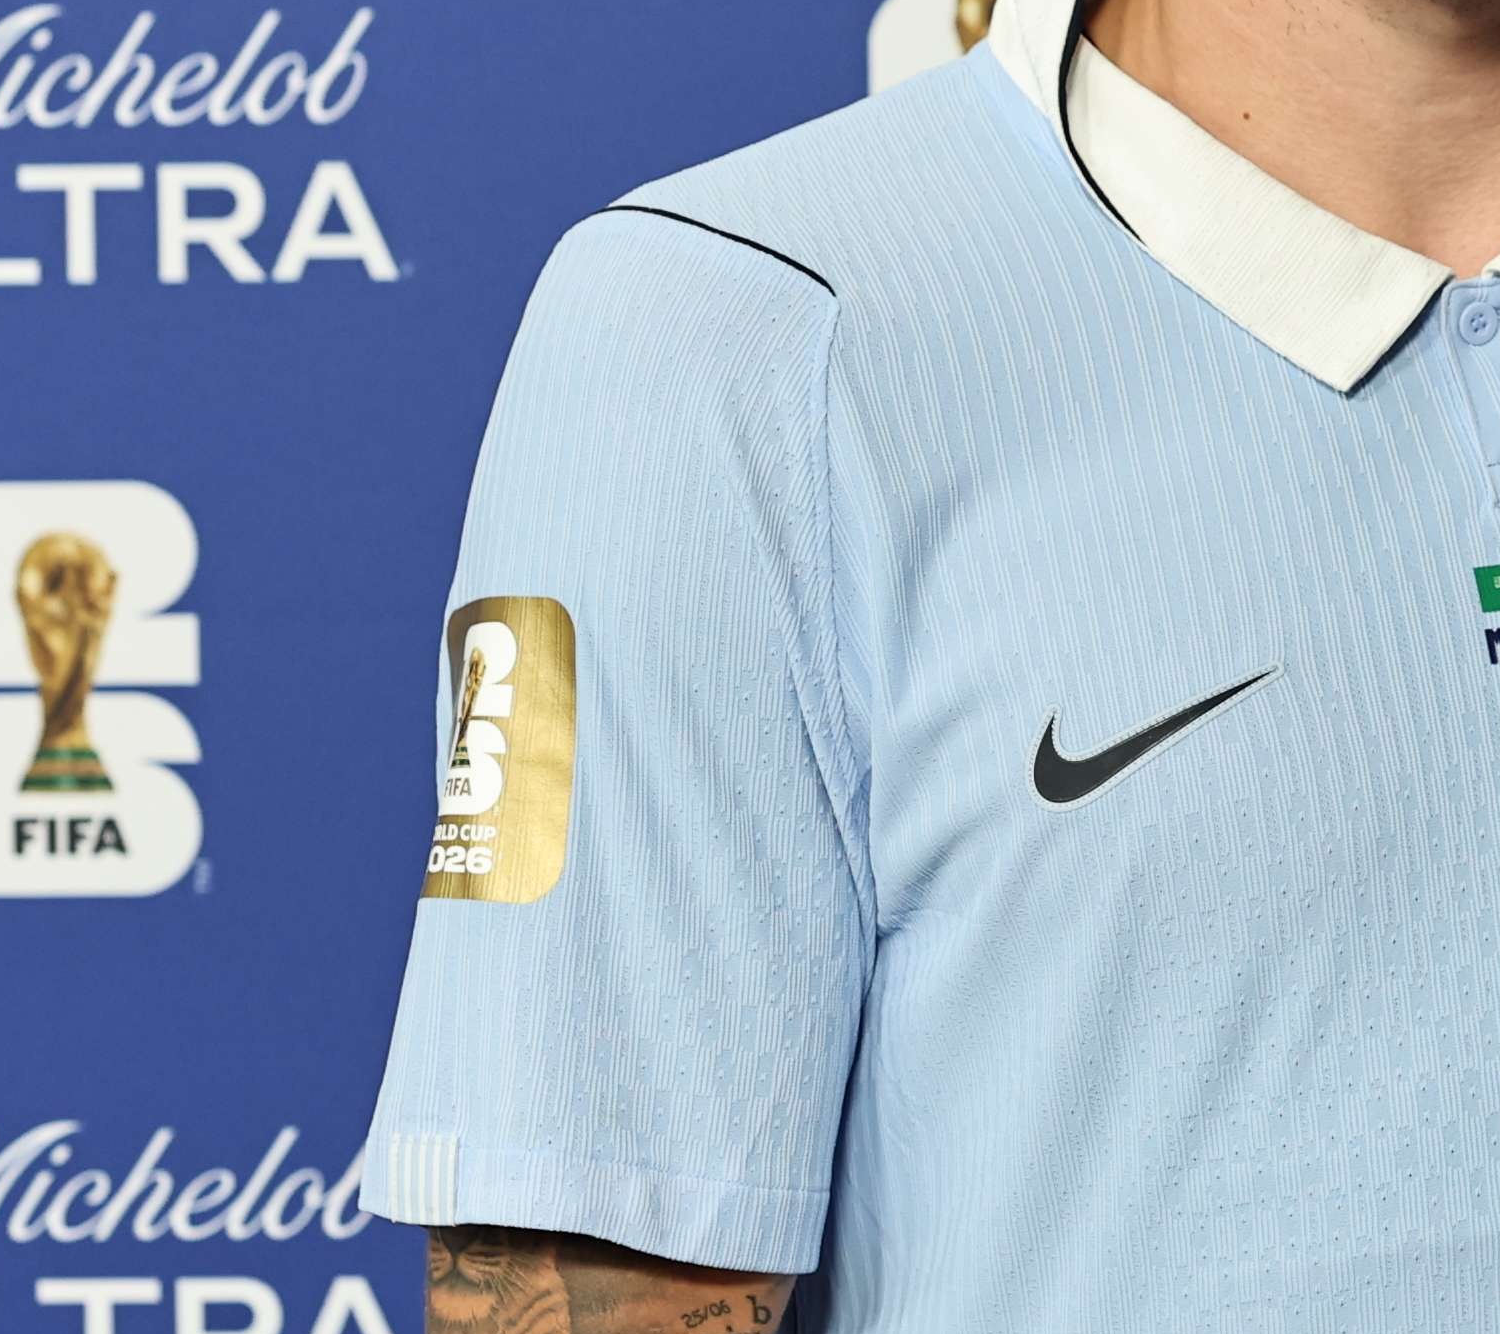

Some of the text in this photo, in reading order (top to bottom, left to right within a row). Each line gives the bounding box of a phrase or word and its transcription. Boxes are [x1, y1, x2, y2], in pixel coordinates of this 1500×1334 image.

[11, 815, 129, 857] FIFA
[433, 823, 497, 843] RLD CUP
[427, 844, 494, 875] 026
